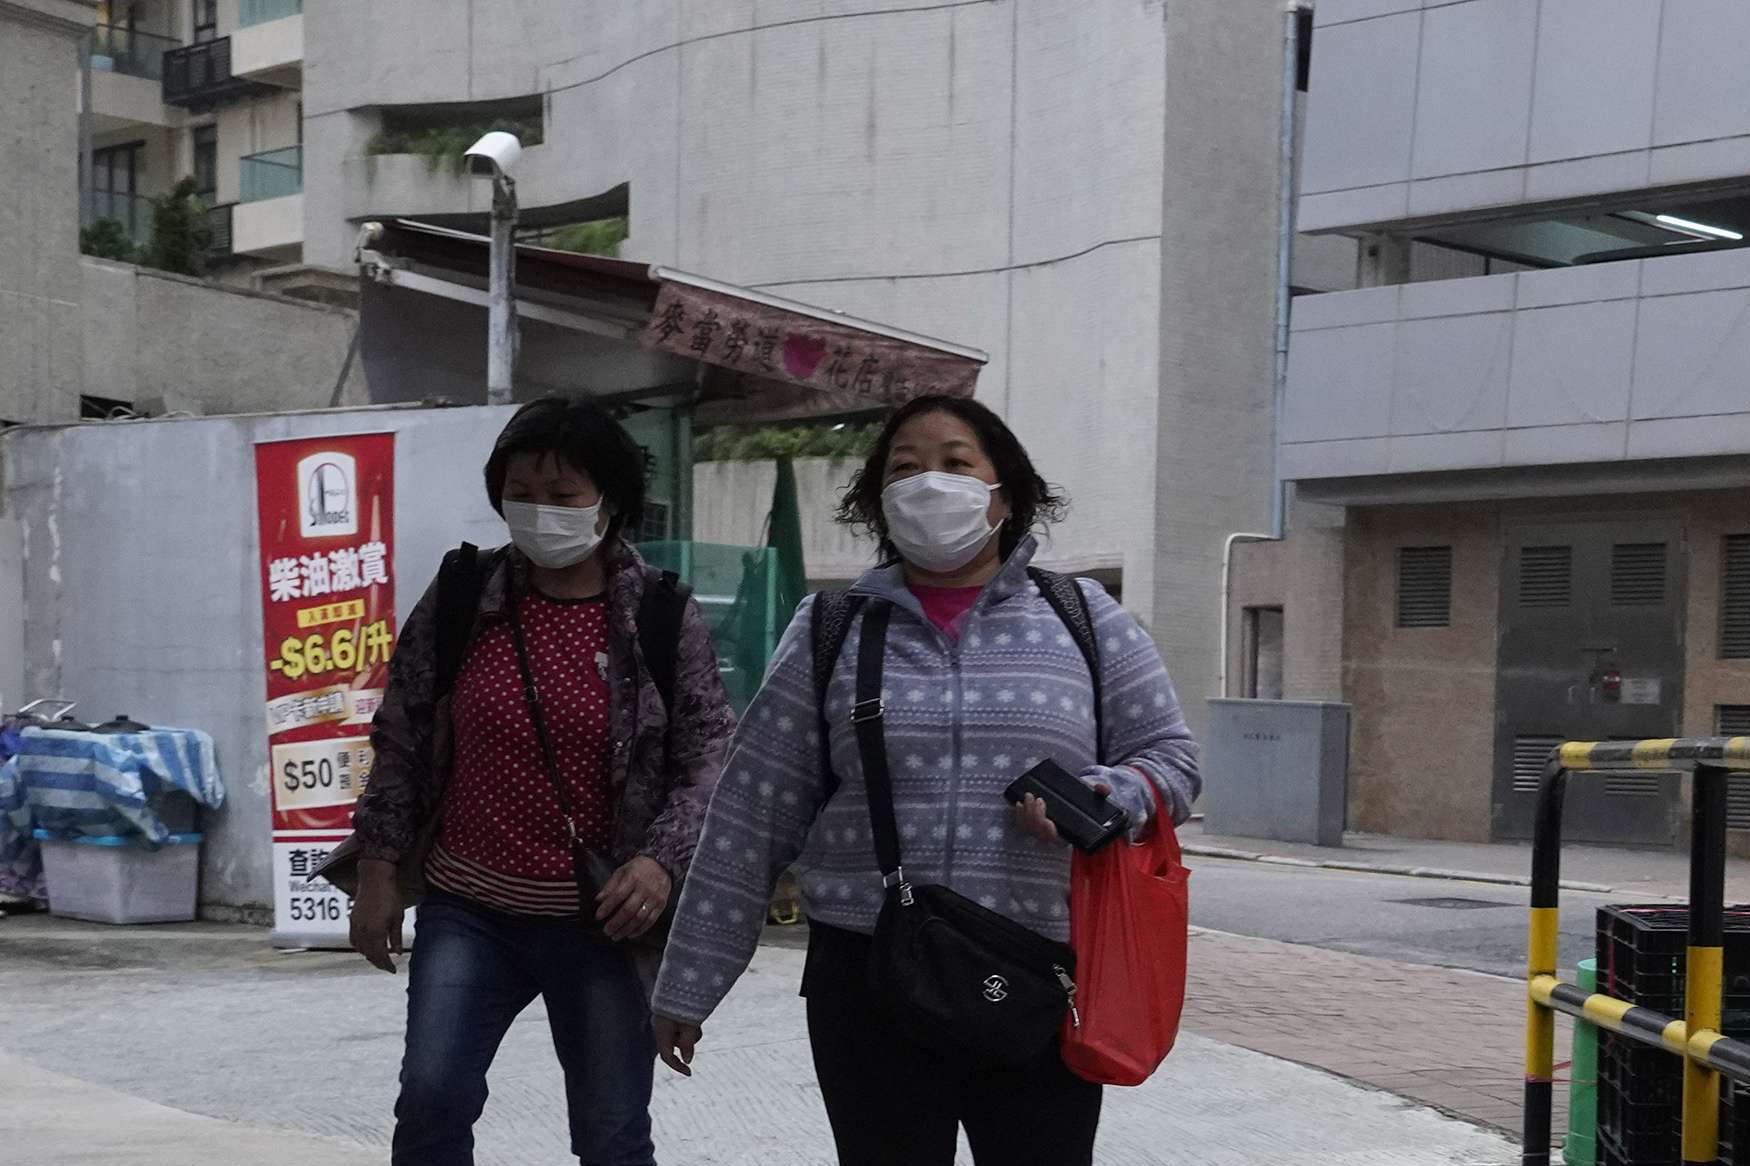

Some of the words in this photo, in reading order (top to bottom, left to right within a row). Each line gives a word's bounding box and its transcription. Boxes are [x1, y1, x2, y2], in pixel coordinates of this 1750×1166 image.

[269, 540, 388, 602] 柴油激賞
[283, 757, 333, 795] $50
[289, 897, 341, 921] 5316
